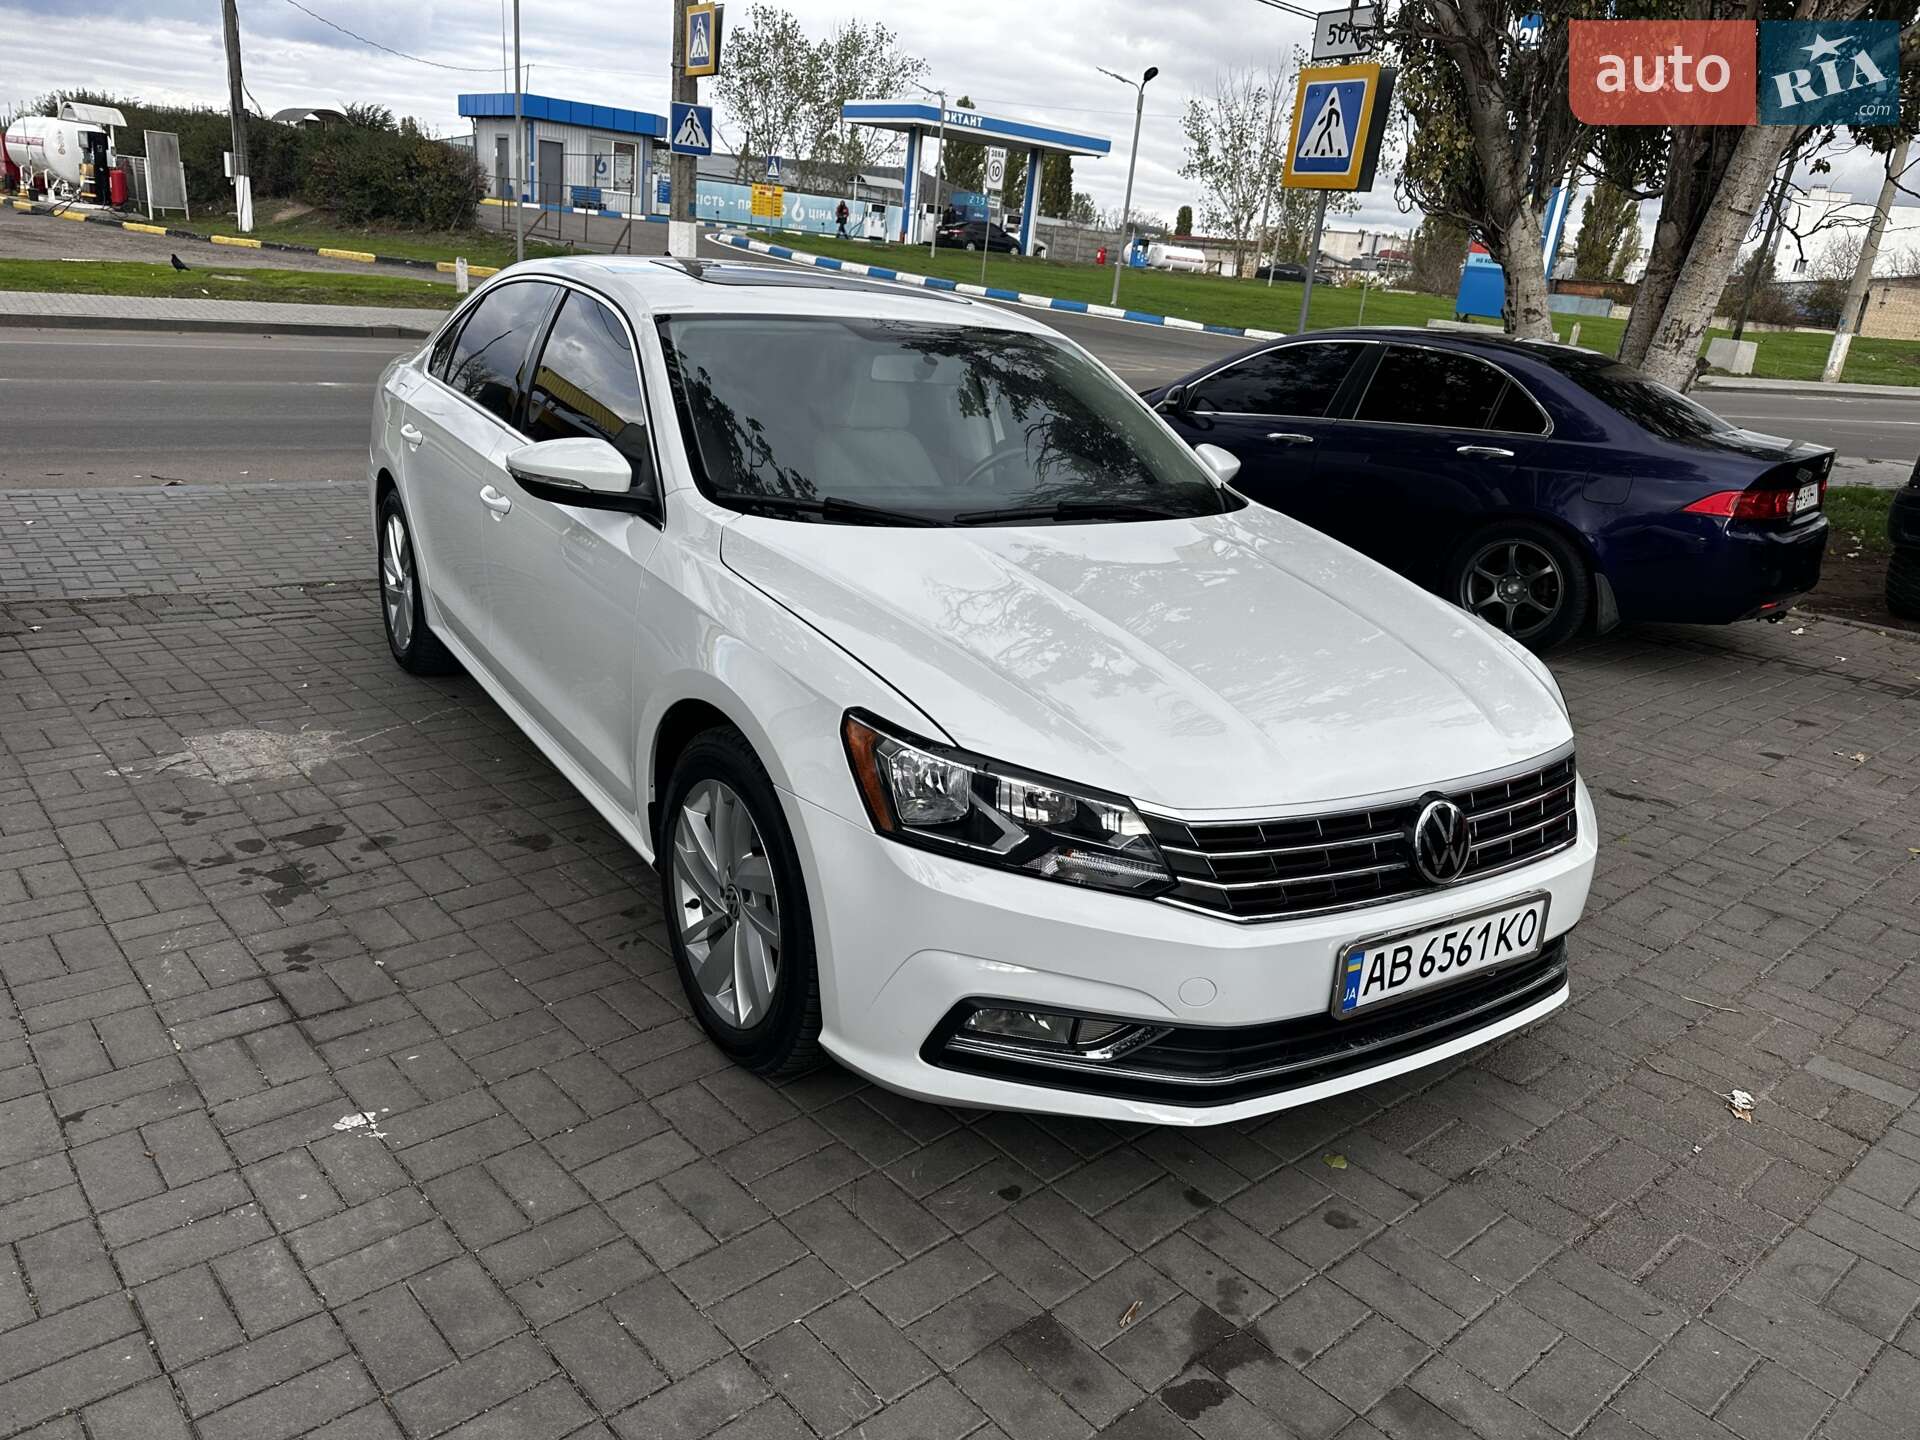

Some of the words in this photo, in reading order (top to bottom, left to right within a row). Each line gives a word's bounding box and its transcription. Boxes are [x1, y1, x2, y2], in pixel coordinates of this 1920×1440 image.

[943, 111, 982, 127] ОКТАНТ
[991, 149, 1004, 158] ЗОНА
[992, 165, 1000, 177] 10
[808, 208, 832, 221] ЦІНА
[1362, 944, 1413, 997] AB
[1419, 921, 1492, 978] 6561
[1494, 908, 1537, 957] KO
